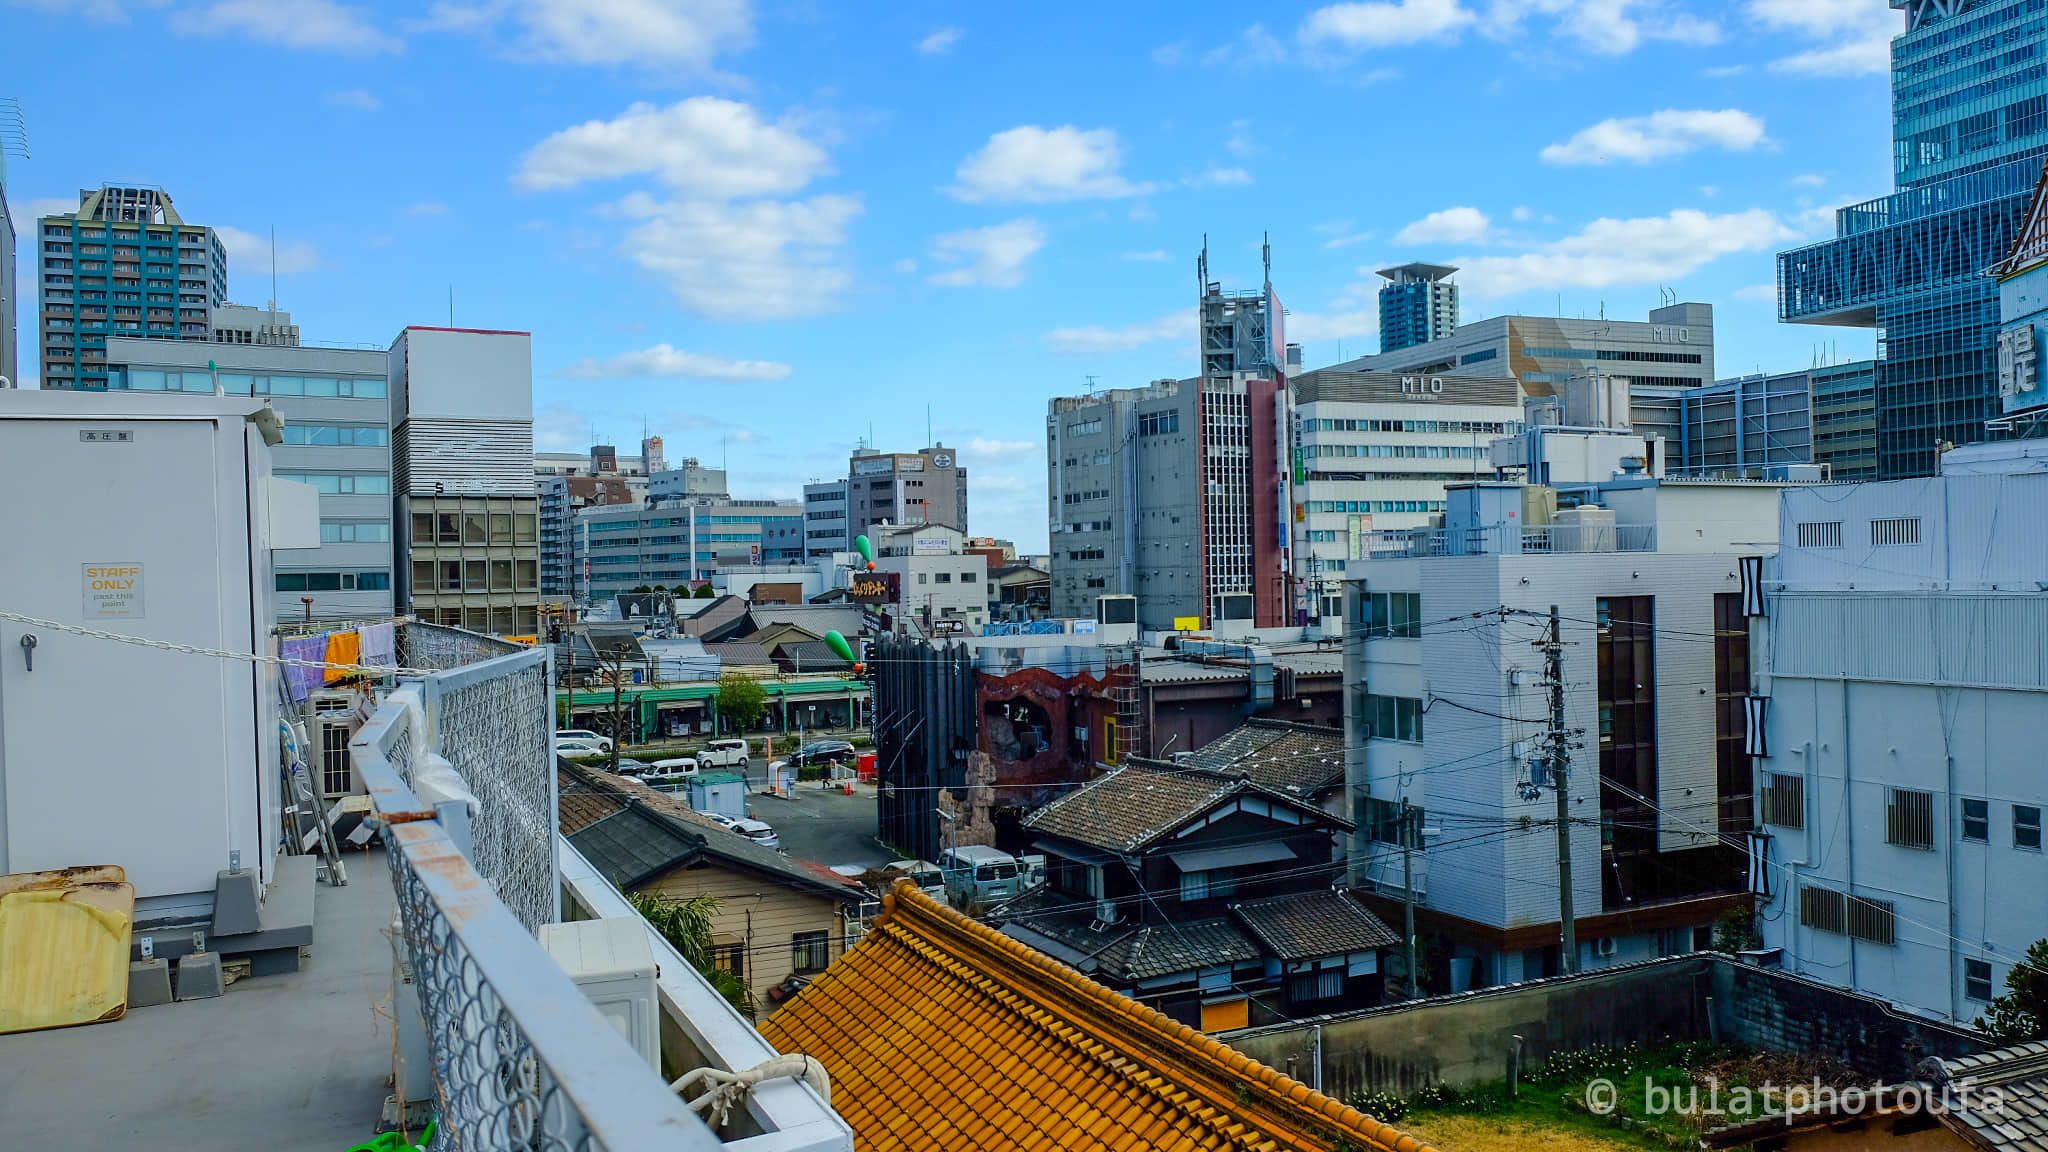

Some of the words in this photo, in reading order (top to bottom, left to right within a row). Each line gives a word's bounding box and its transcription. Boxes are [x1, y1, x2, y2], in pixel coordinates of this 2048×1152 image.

[1653, 327, 1689, 341] MIO
[1401, 376, 1442, 393] MIO
[87, 567, 138, 578] STAFF
[92, 579, 134, 590] ONLY
[102, 600, 125, 608] point
